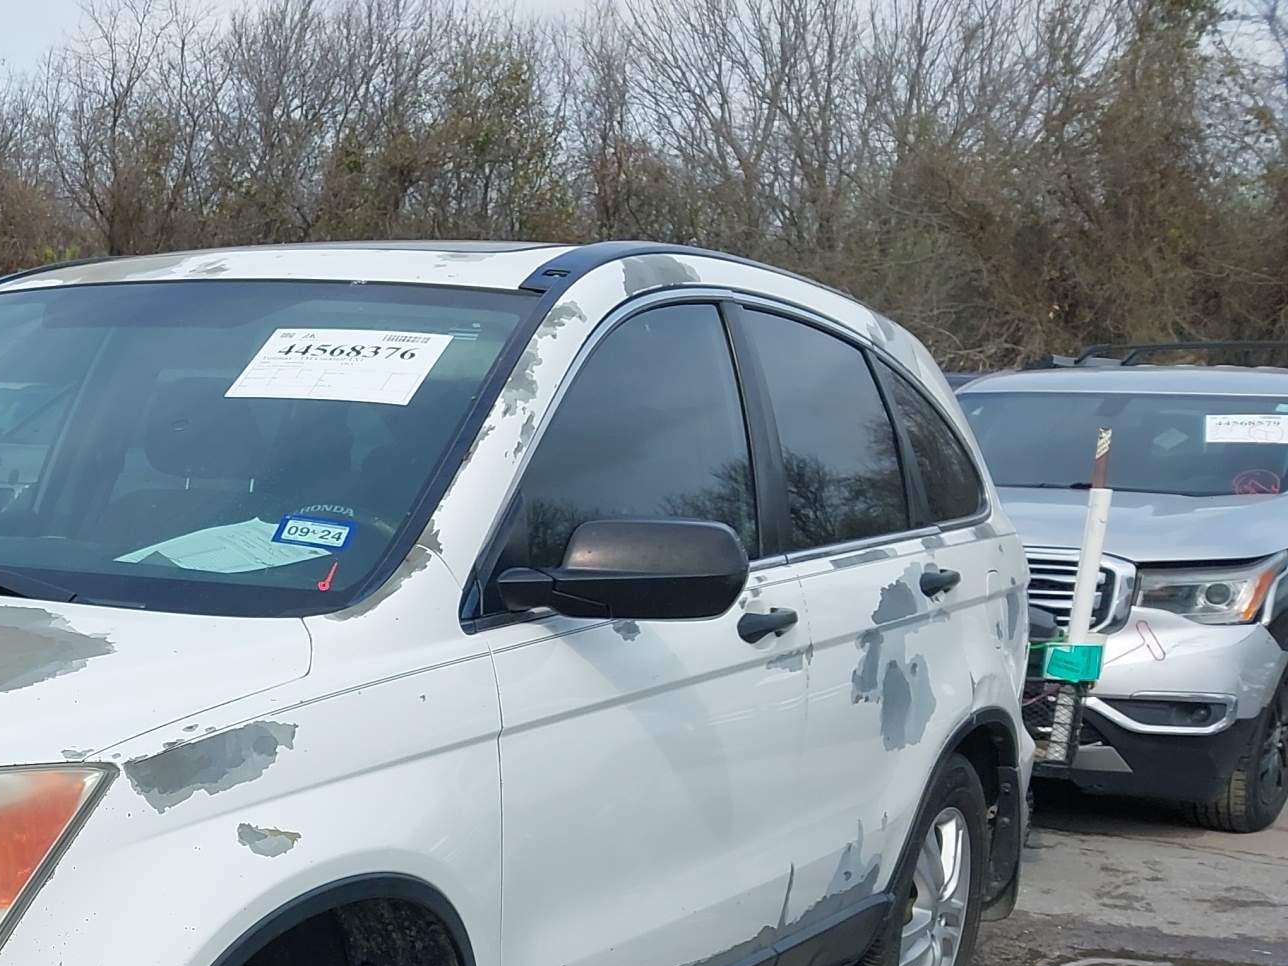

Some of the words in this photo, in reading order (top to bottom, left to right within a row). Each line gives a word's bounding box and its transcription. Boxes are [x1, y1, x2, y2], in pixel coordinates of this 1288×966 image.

[278, 343, 421, 361] 44568376
[300, 504, 354, 517] HONDA
[287, 525, 311, 537] 09
[318, 529, 344, 542] 24
